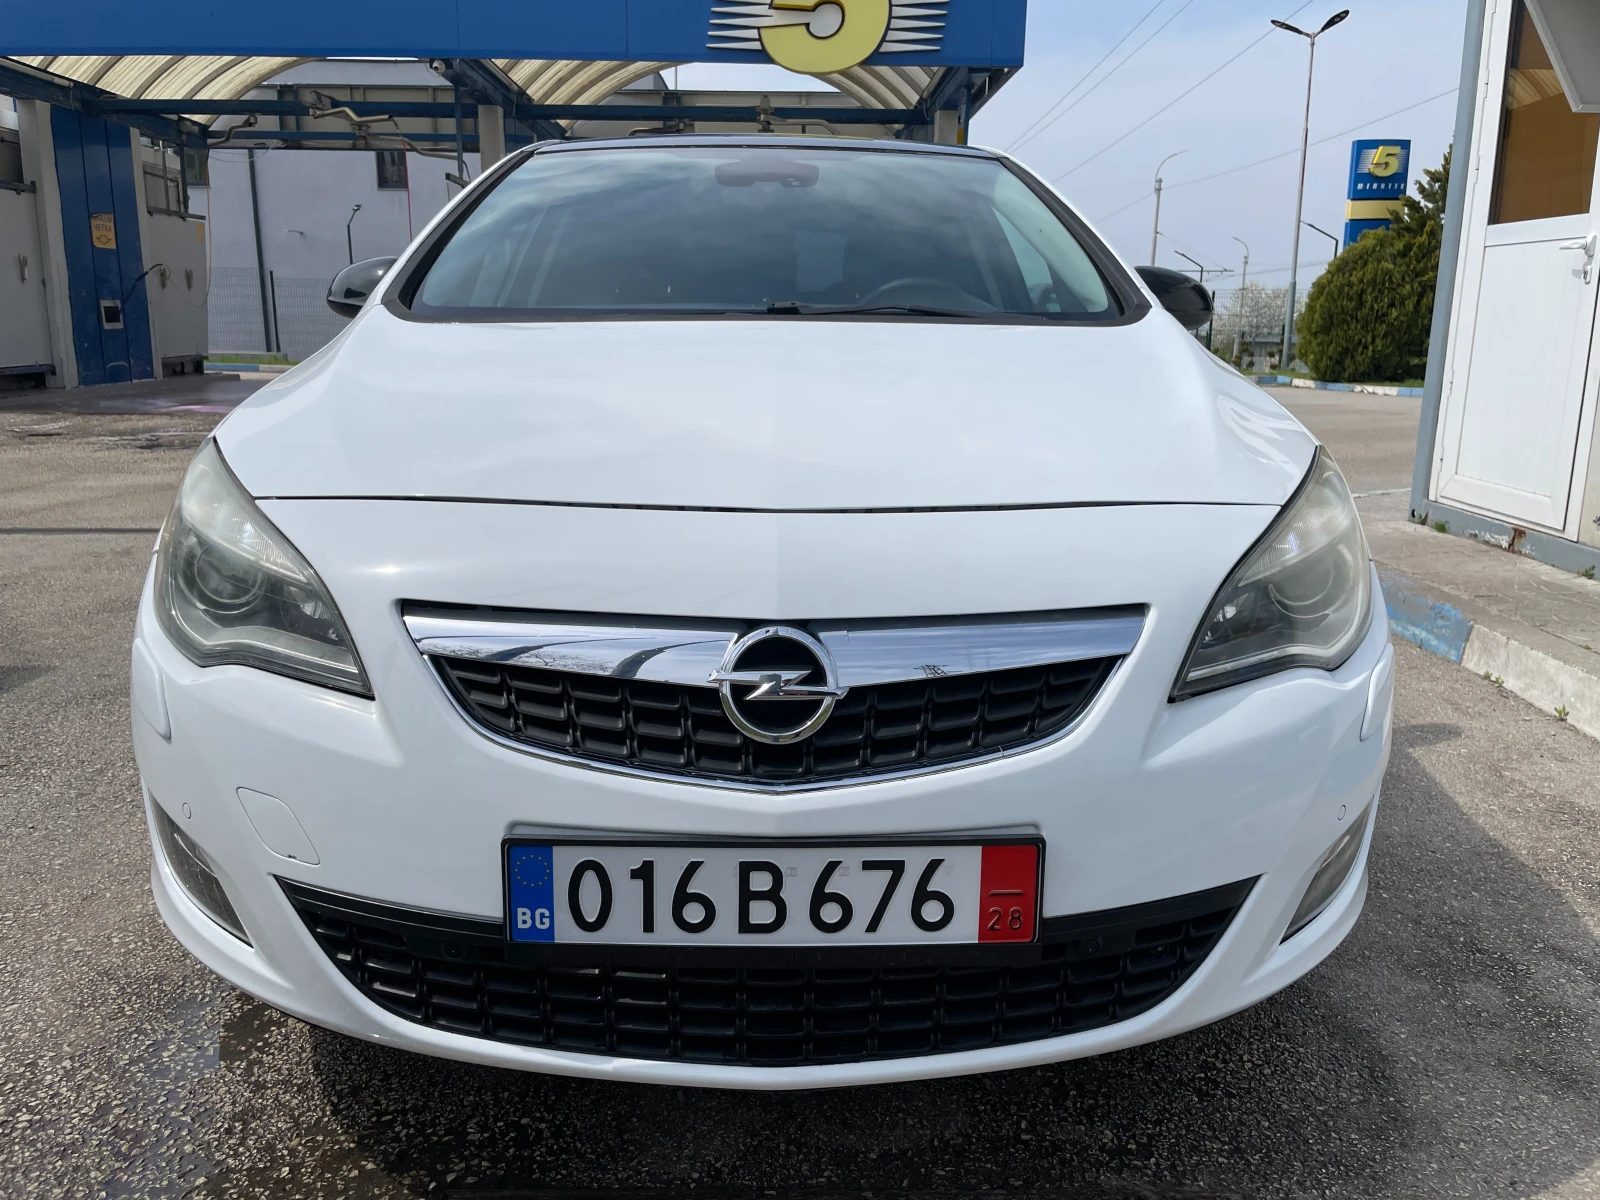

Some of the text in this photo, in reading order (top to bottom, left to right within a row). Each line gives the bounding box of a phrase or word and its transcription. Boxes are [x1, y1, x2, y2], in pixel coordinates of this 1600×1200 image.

[1368, 145, 1402, 178] 5
[1356, 182, 1405, 190] MINUTES
[517, 907, 550, 930] BG
[987, 906, 1023, 931] 28
